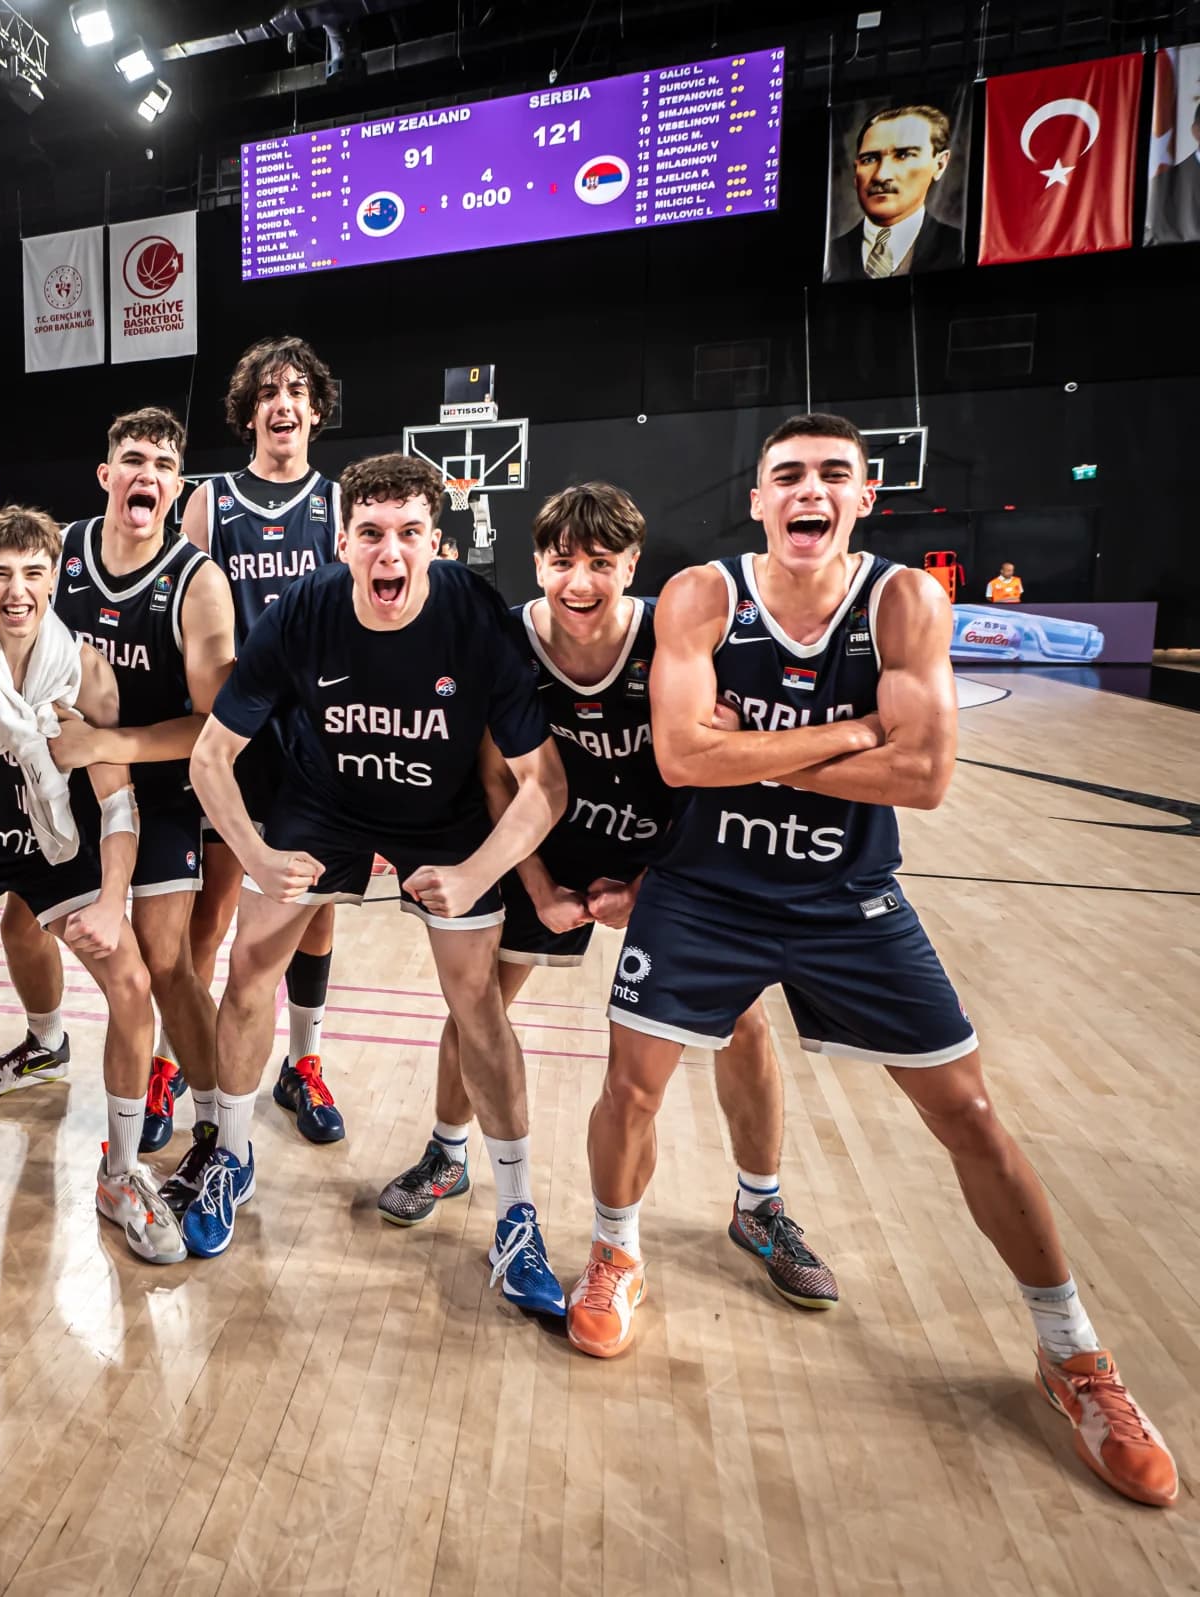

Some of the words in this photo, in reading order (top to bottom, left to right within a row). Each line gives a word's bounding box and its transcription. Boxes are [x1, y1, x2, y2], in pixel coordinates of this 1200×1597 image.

[643, 75, 650, 83] 2
[659, 67, 691, 80] GALIC
[693, 65, 703, 74] L.
[770, 51, 784, 60] 10
[643, 88, 649, 96] 3
[659, 79, 705, 93] DUROVIC
[772, 64, 780, 73] 4
[529, 86, 591, 109] SERBIA
[642, 101, 648, 109] 7
[658, 88, 724, 106] STEPANOVIC
[769, 77, 783, 87] 10
[639, 126, 651, 135] 10
[658, 115, 720, 132] VESELINOVI
[771, 105, 778, 114] 2
[658, 101, 726, 119] SIMJANOVSK
[360, 122, 395, 139] NEW
[398, 108, 471, 132] ZEALAND
[533, 120, 582, 147] 121
[638, 139, 649, 148] 11
[657, 132, 689, 145] LUKIC
[691, 130, 703, 139] M.
[768, 119, 780, 128] 11
[256, 141, 279, 151] CECIL
[341, 128, 351, 137] 37
[657, 142, 708, 157] SAPONJIC
[256, 153, 283, 163] PRYOR
[256, 164, 285, 174] KEOGH
[341, 152, 351, 160] 11
[404, 145, 433, 169] 91
[656, 154, 717, 170] MILADINOVI
[769, 146, 776, 154] 4
[256, 174, 290, 186] DUNCAN
[480, 168, 493, 183] 4
[655, 181, 716, 197] KUSTURICA
[764, 172, 778, 182] 27
[656, 170, 699, 184] BJELICA
[256, 186, 289, 197] COUPER
[462, 187, 512, 210] 0:00
[635, 203, 647, 212] 31
[655, 197, 694, 209] MILICIC
[764, 185, 777, 195] 11
[256, 198, 277, 209] CATE
[256, 207, 295, 219] RAMPTON
[654, 208, 704, 222] PAVLOVIC
[763, 198, 776, 208] 11
[256, 231, 287, 242] PATTEN
[256, 243, 277, 253] SULA
[256, 264, 296, 276] THOMSON
[36, 315, 48, 324] T.C.
[82, 309, 91, 318] VE
[123, 299, 184, 319] TÜRKİYE
[34, 324, 53, 335] SPOR
[124, 313, 184, 329] BASKETBOL
[124, 322, 184, 337] FEDERASYONU
[469, 368, 480, 383] 0
[457, 406, 490, 416] TISSOT
[229, 550, 316, 581] SRBIJA
[324, 703, 450, 740] SRBIJA
[337, 752, 433, 787] mts
[569, 798, 658, 842] mts
[717, 810, 845, 862] mts
